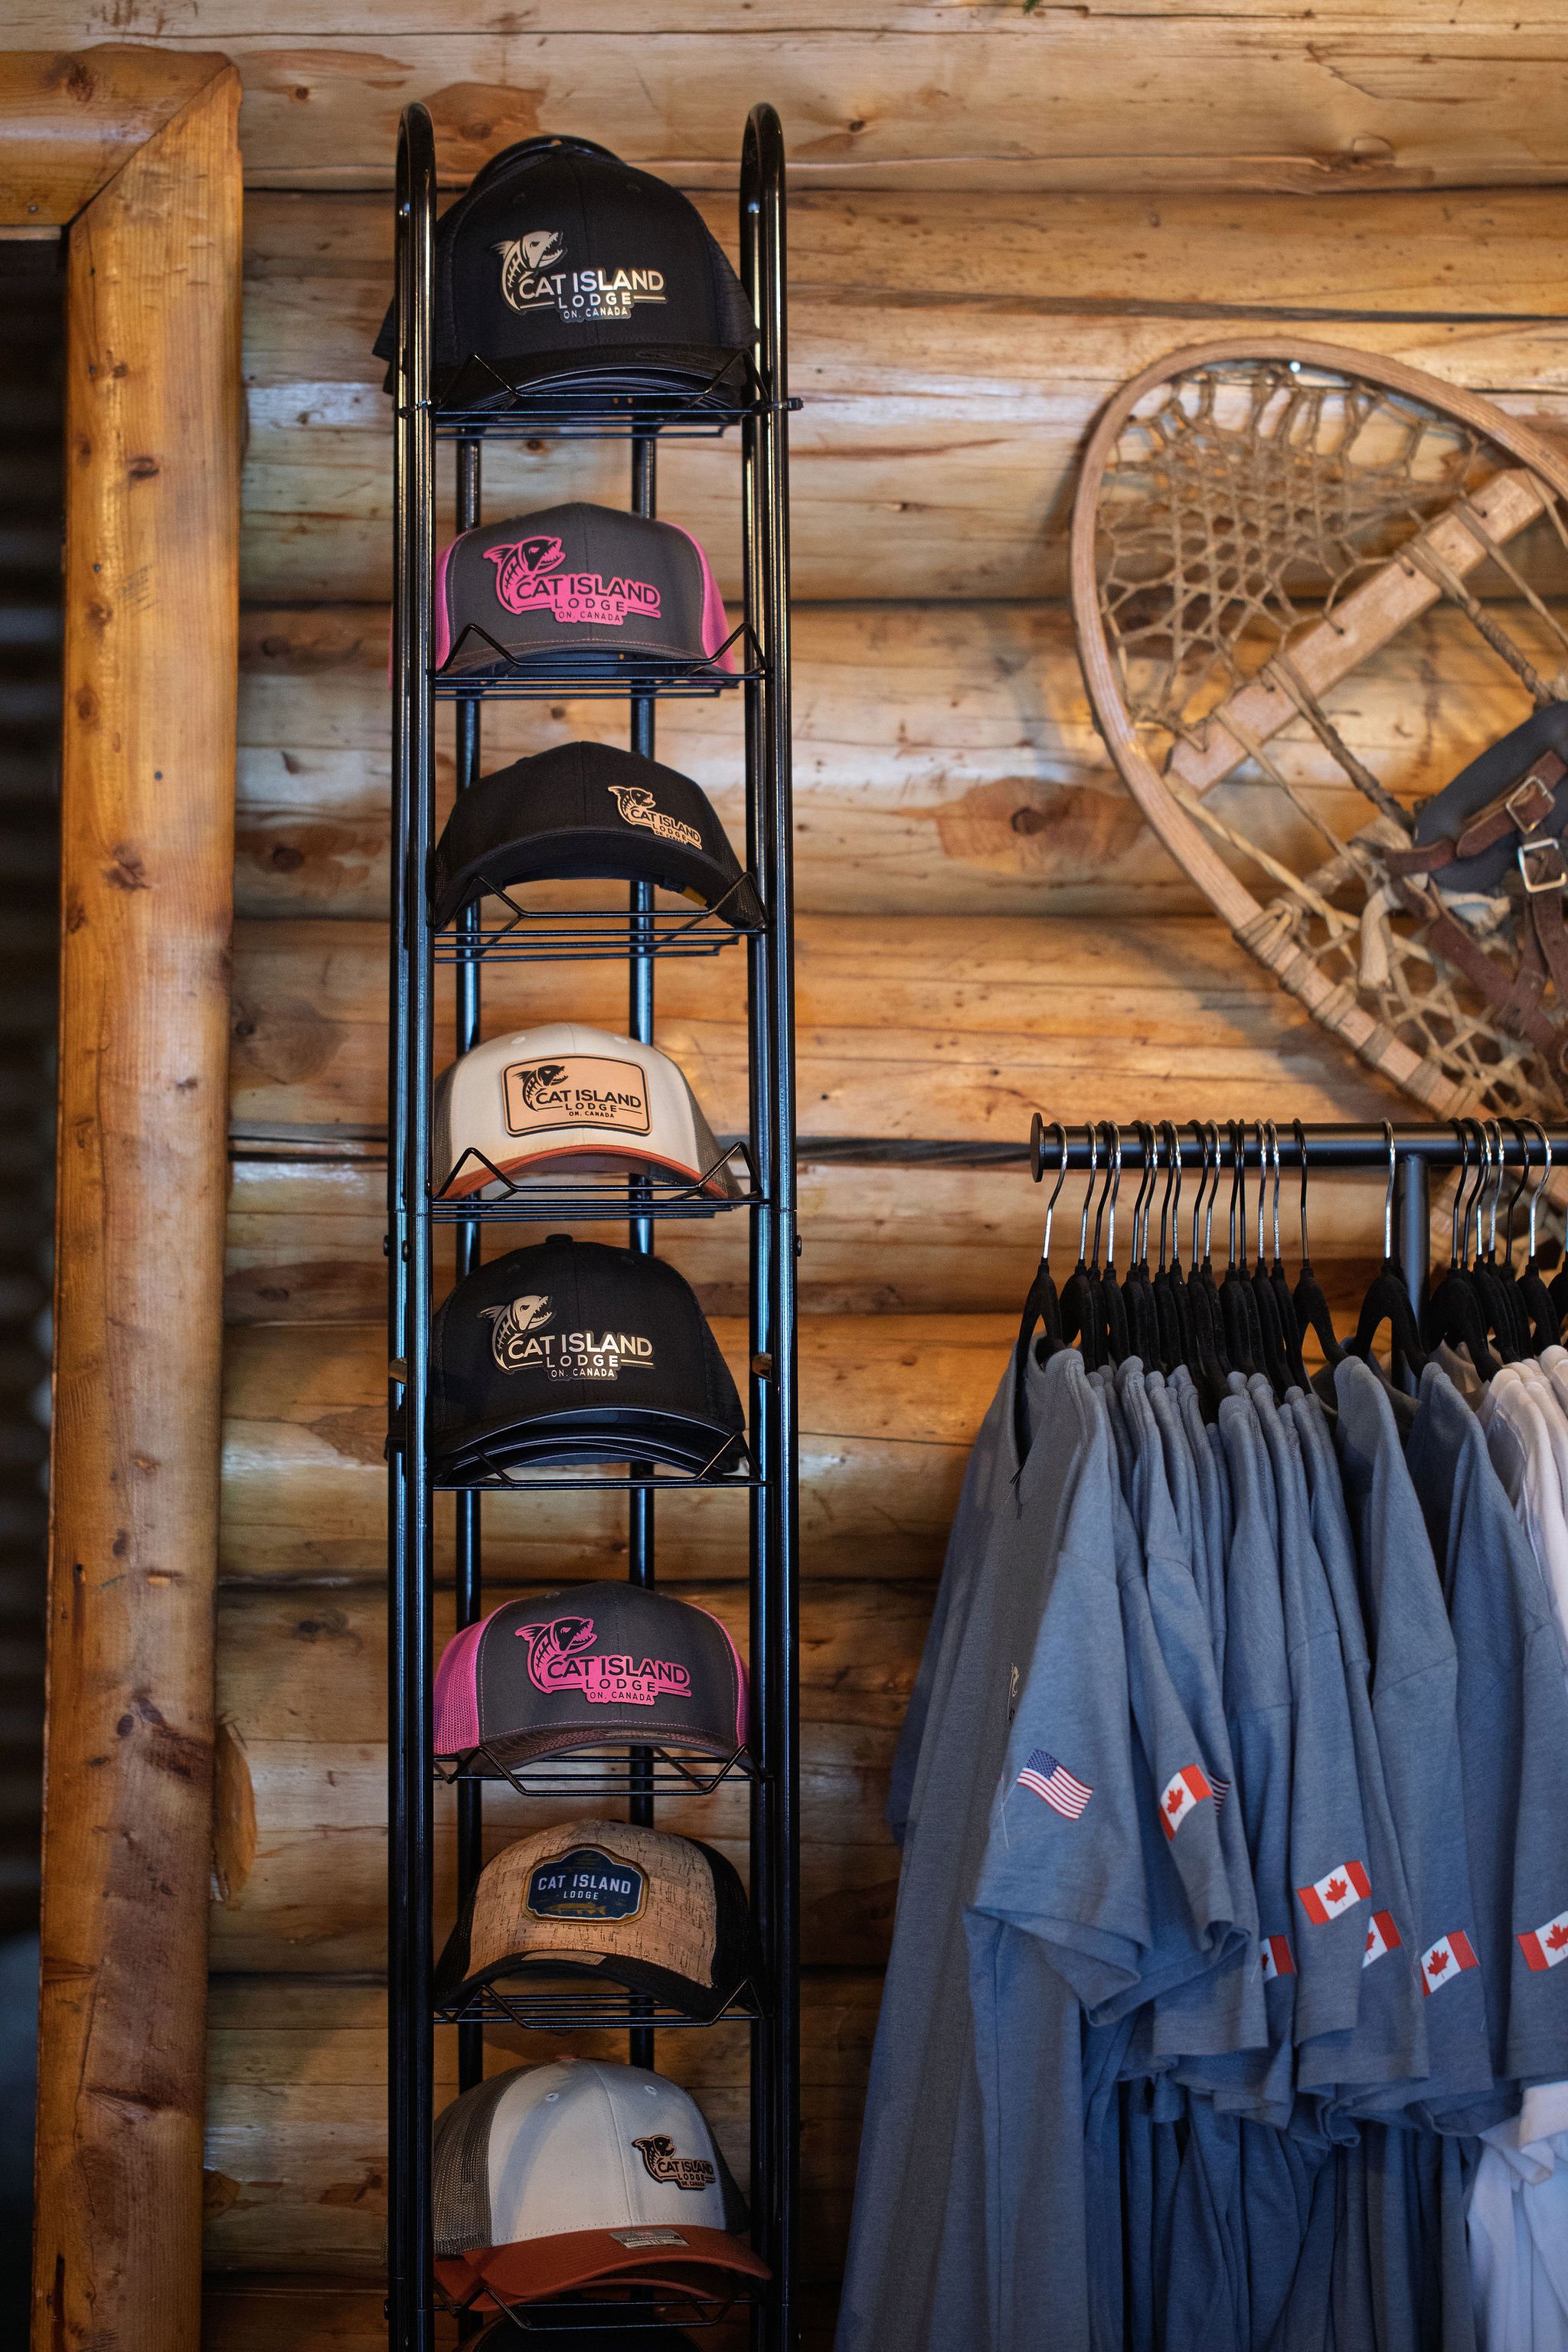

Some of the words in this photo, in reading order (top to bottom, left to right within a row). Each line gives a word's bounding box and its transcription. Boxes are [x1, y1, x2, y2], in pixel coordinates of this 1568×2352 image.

[519, 274, 567, 299] CAT
[573, 270, 664, 292] ISLAND
[558, 292, 632, 309] LODGE
[564, 310, 581, 319] ON.
[586, 307, 629, 317] CANADA
[516, 578, 564, 599] CAT
[570, 577, 658, 605] ISLAND
[554, 598, 625, 612] LODGE
[580, 611, 621, 622] CANADA
[630, 809, 656, 822] CAT
[659, 816, 700, 841] ISLAND
[652, 823, 687, 841] LODGE
[536, 1089, 572, 1105] CAT
[576, 1089, 642, 1108] ISLAND
[565, 1102, 617, 1112] LODGE
[508, 1335, 555, 1360] CAT
[562, 1333, 653, 1356] ISLAND
[547, 1354, 619, 1368] LODGE
[573, 1368, 615, 1377] CANADA
[547, 1658, 595, 1679] CAT
[602, 1658, 688, 1684] ISLAND
[586, 1678, 656, 1693] LODGE
[590, 1691, 607, 1700] ON.
[612, 1691, 652, 1702] CANADA
[537, 1875, 566, 1890] CAT
[573, 1873, 632, 1894] ISLAND
[564, 1890, 599, 1900] LODGE
[658, 2161, 679, 2173] CAT
[681, 2161, 714, 2175] ISLAND
